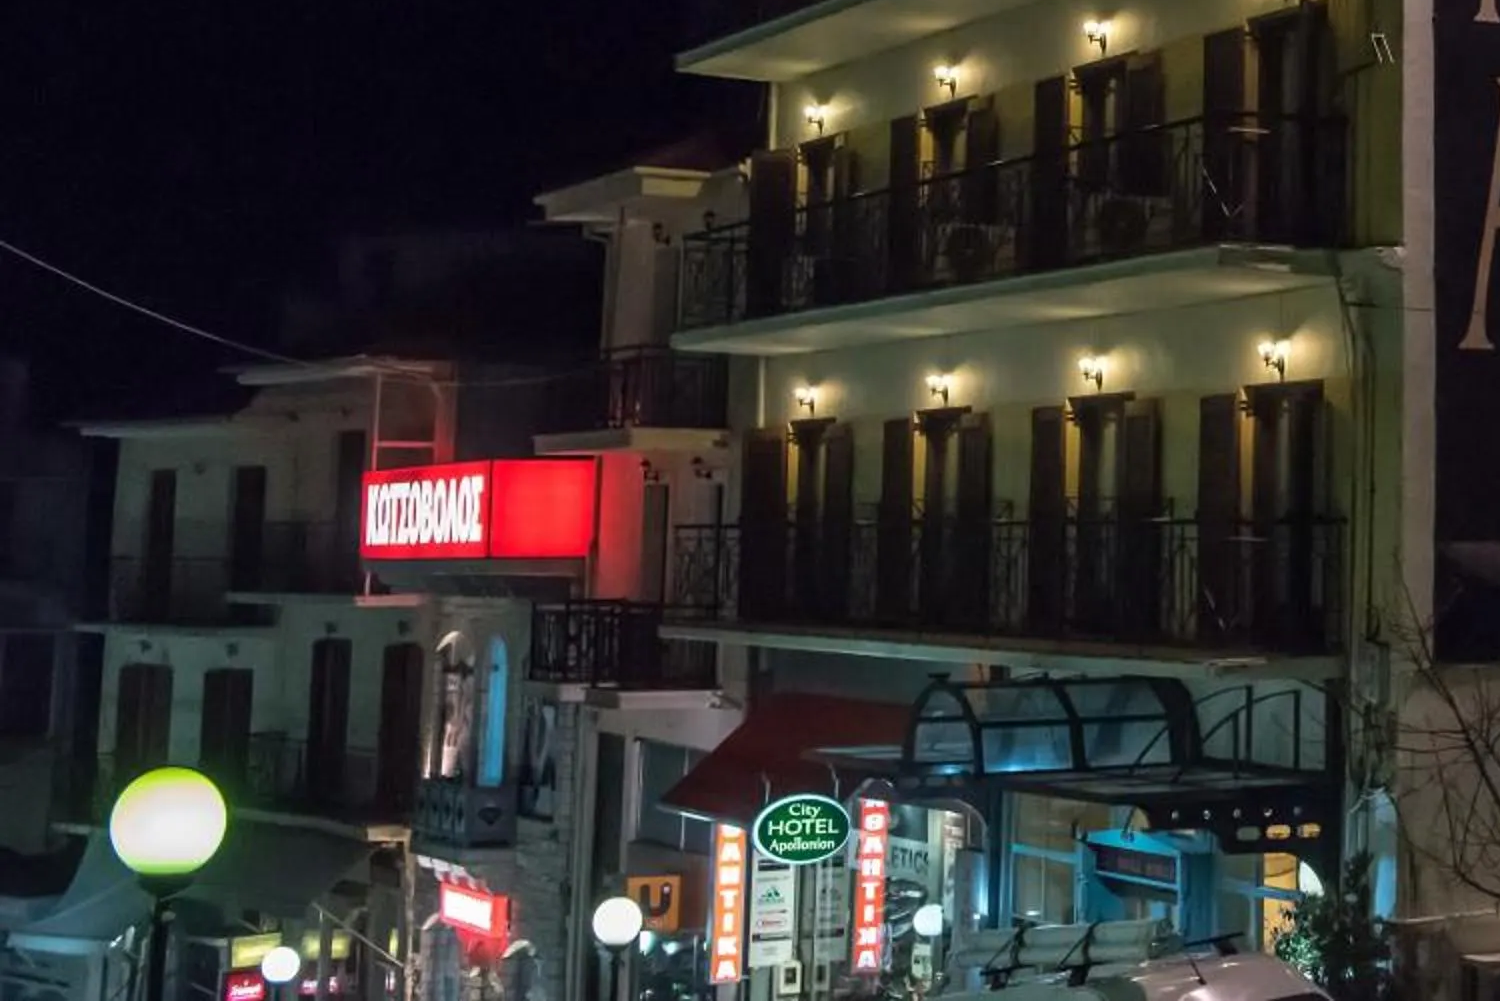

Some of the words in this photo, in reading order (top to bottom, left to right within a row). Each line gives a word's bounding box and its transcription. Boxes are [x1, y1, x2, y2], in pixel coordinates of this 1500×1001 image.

[366, 474, 484, 545] ΚΩΤΣΟΒΟΛΟΣ
[789, 803, 820, 818] City
[768, 818, 839, 835] HOTEL
